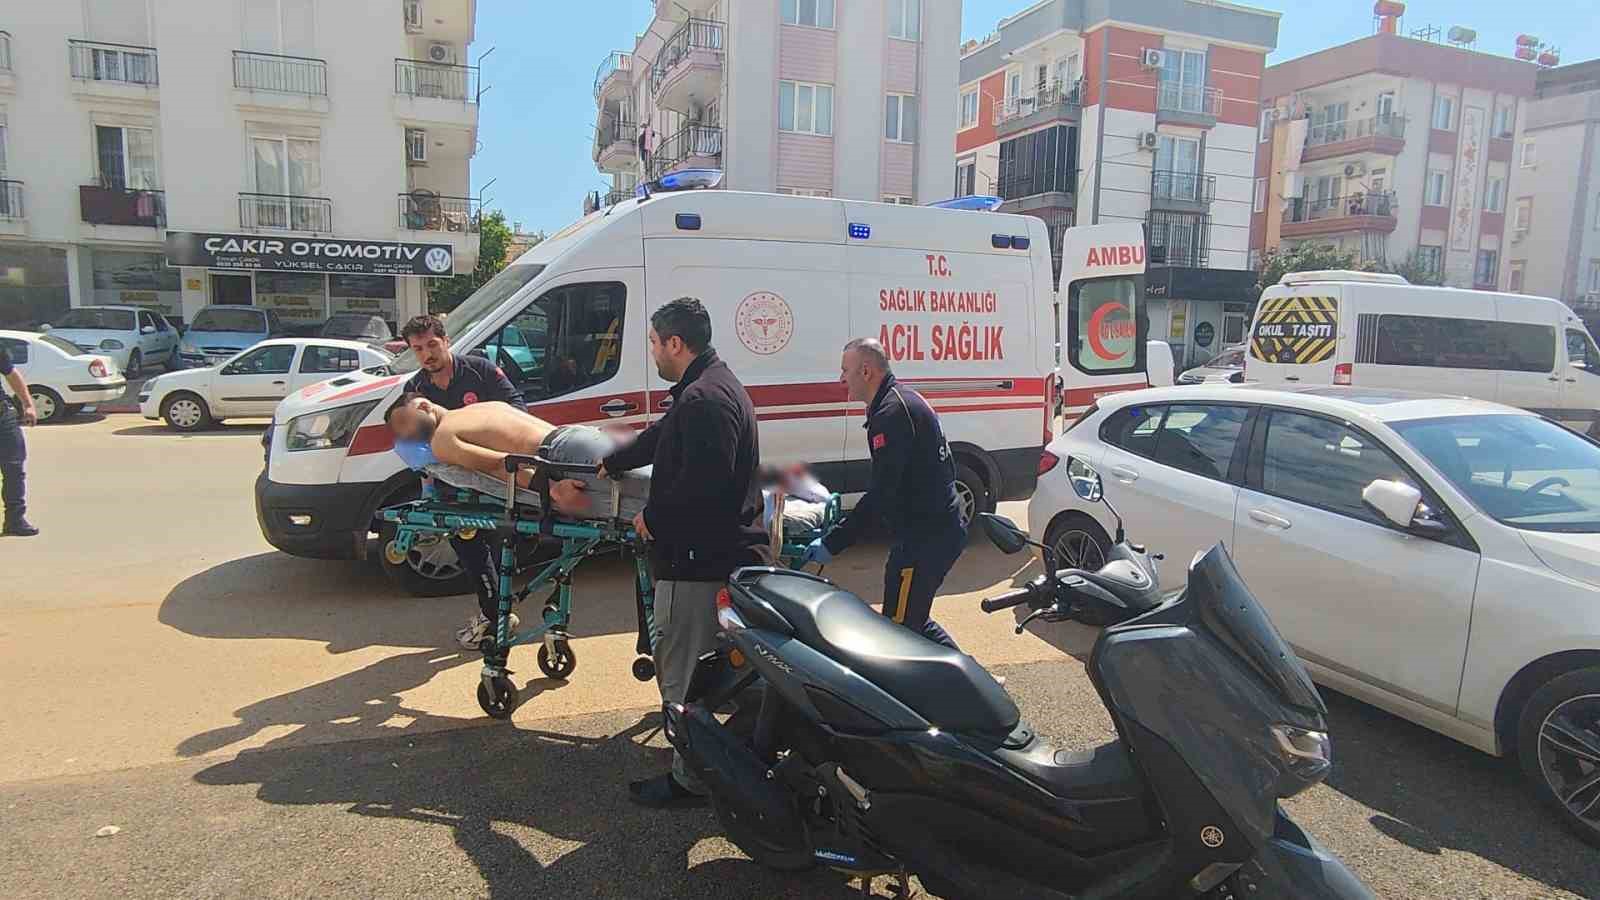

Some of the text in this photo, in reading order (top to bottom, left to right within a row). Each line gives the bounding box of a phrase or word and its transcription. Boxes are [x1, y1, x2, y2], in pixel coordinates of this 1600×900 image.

[204, 237, 421, 260] ÇAKIR OTOMOTİV
[1086, 246, 1144, 266] AMBU
[926, 254, 952, 276] T.C.
[880, 286, 996, 313] SAĞLIK BAKANLIĞI
[931, 320, 1004, 361] SAĞLIK
[1259, 324, 1332, 339] OKUL TAŞITI
